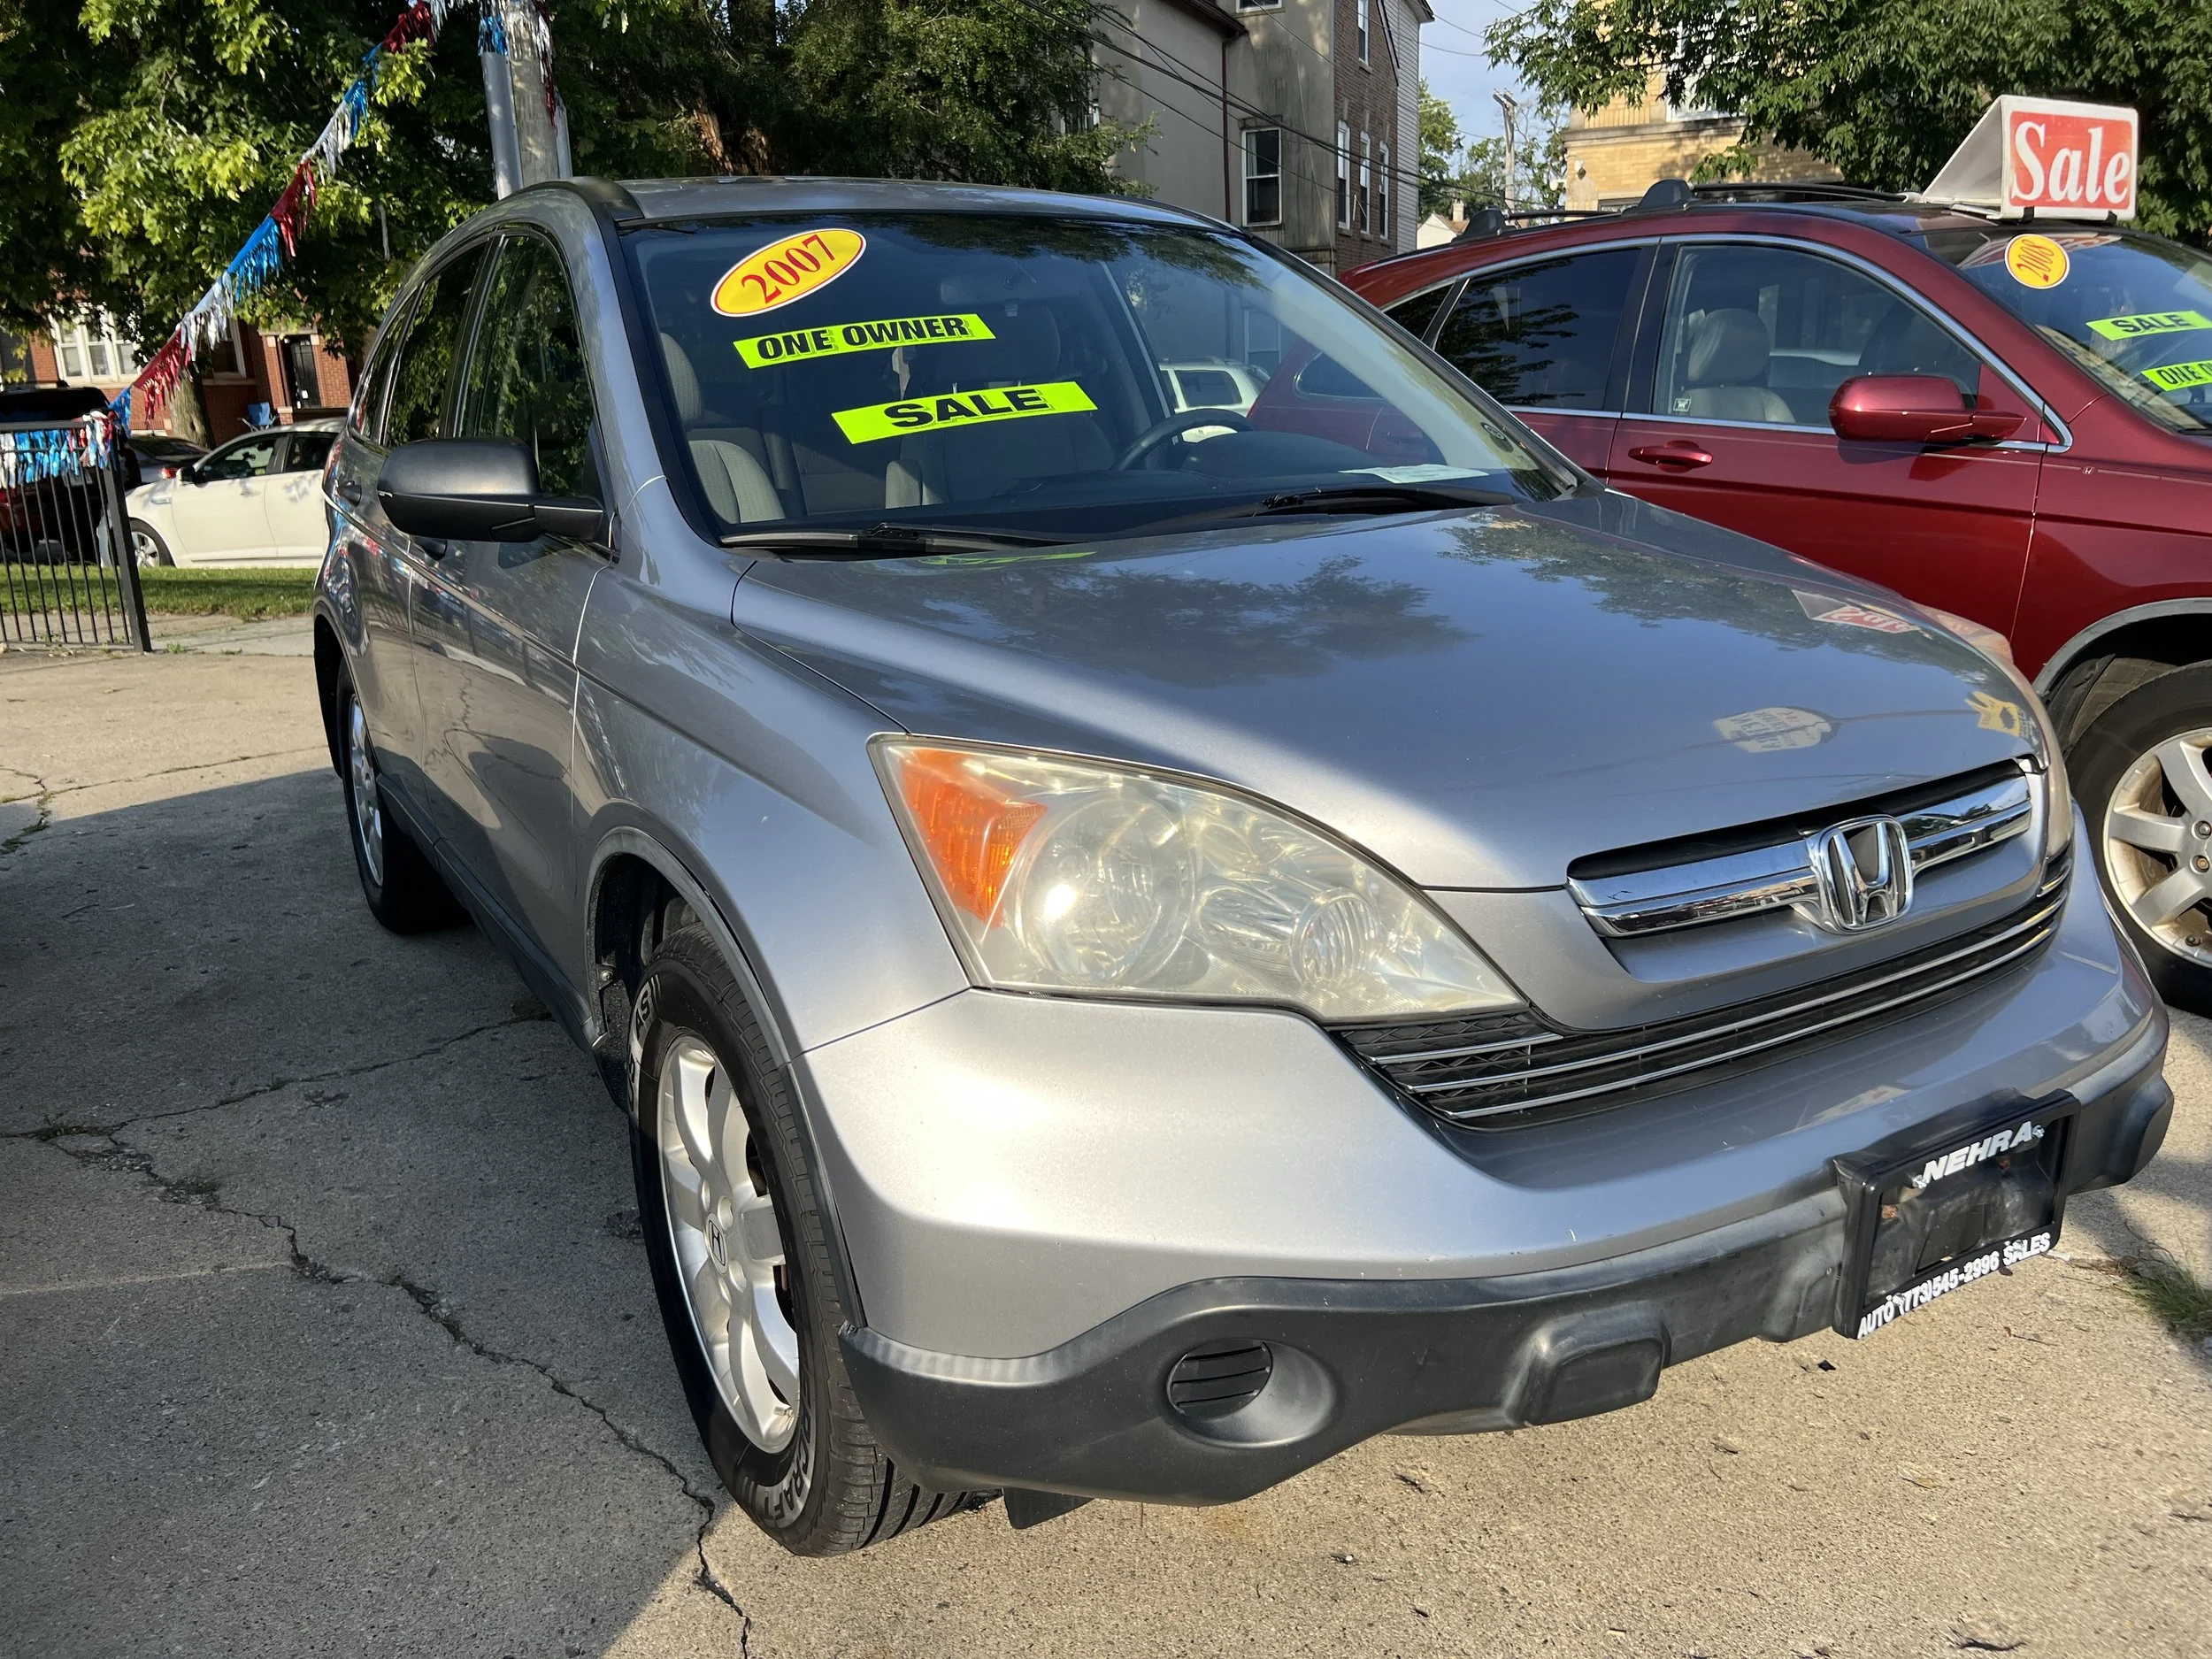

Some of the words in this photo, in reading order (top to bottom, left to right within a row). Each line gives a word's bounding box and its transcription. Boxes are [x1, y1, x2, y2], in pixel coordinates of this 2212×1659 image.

[2011, 121, 2131, 204] Sale
[741, 234, 835, 303] 2007
[2016, 239, 2055, 282] 2008
[757, 328, 835, 361] ONE
[842, 317, 971, 347] OWNER
[2111, 315, 2191, 333] SALE
[2156, 365, 2203, 385] ONE
[884, 388, 1049, 428] SALE
[1922, 1121, 2032, 1182] NEHRA
[1857, 1299, 1895, 1339] AUTO
[2003, 1233, 2051, 1265] SALES
